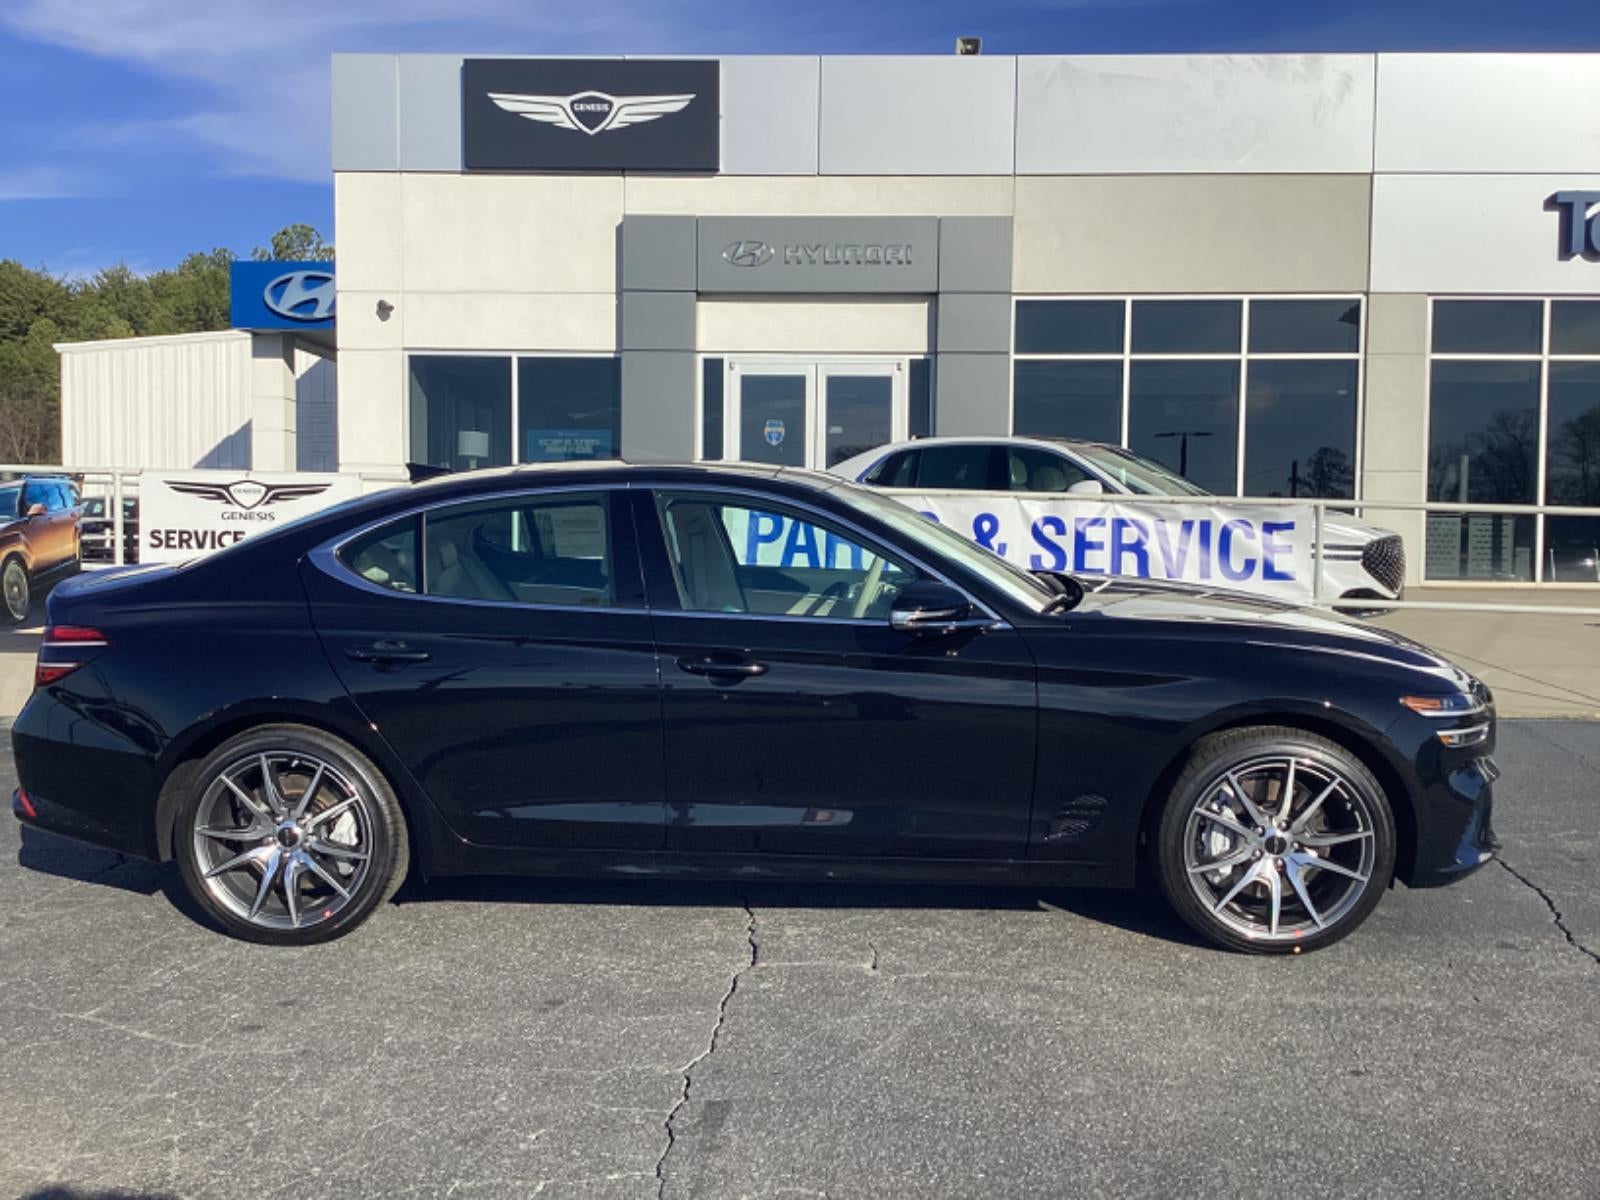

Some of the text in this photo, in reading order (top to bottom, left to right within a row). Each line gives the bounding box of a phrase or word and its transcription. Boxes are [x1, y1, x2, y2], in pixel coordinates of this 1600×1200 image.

[574, 103, 610, 112] GENESIS
[784, 244, 913, 265] HYUNDAI
[221, 511, 276, 521] GENESIS
[149, 529, 246, 549] SERVICE
[972, 513, 1007, 557] &
[1029, 515, 1297, 581] SERVICE
